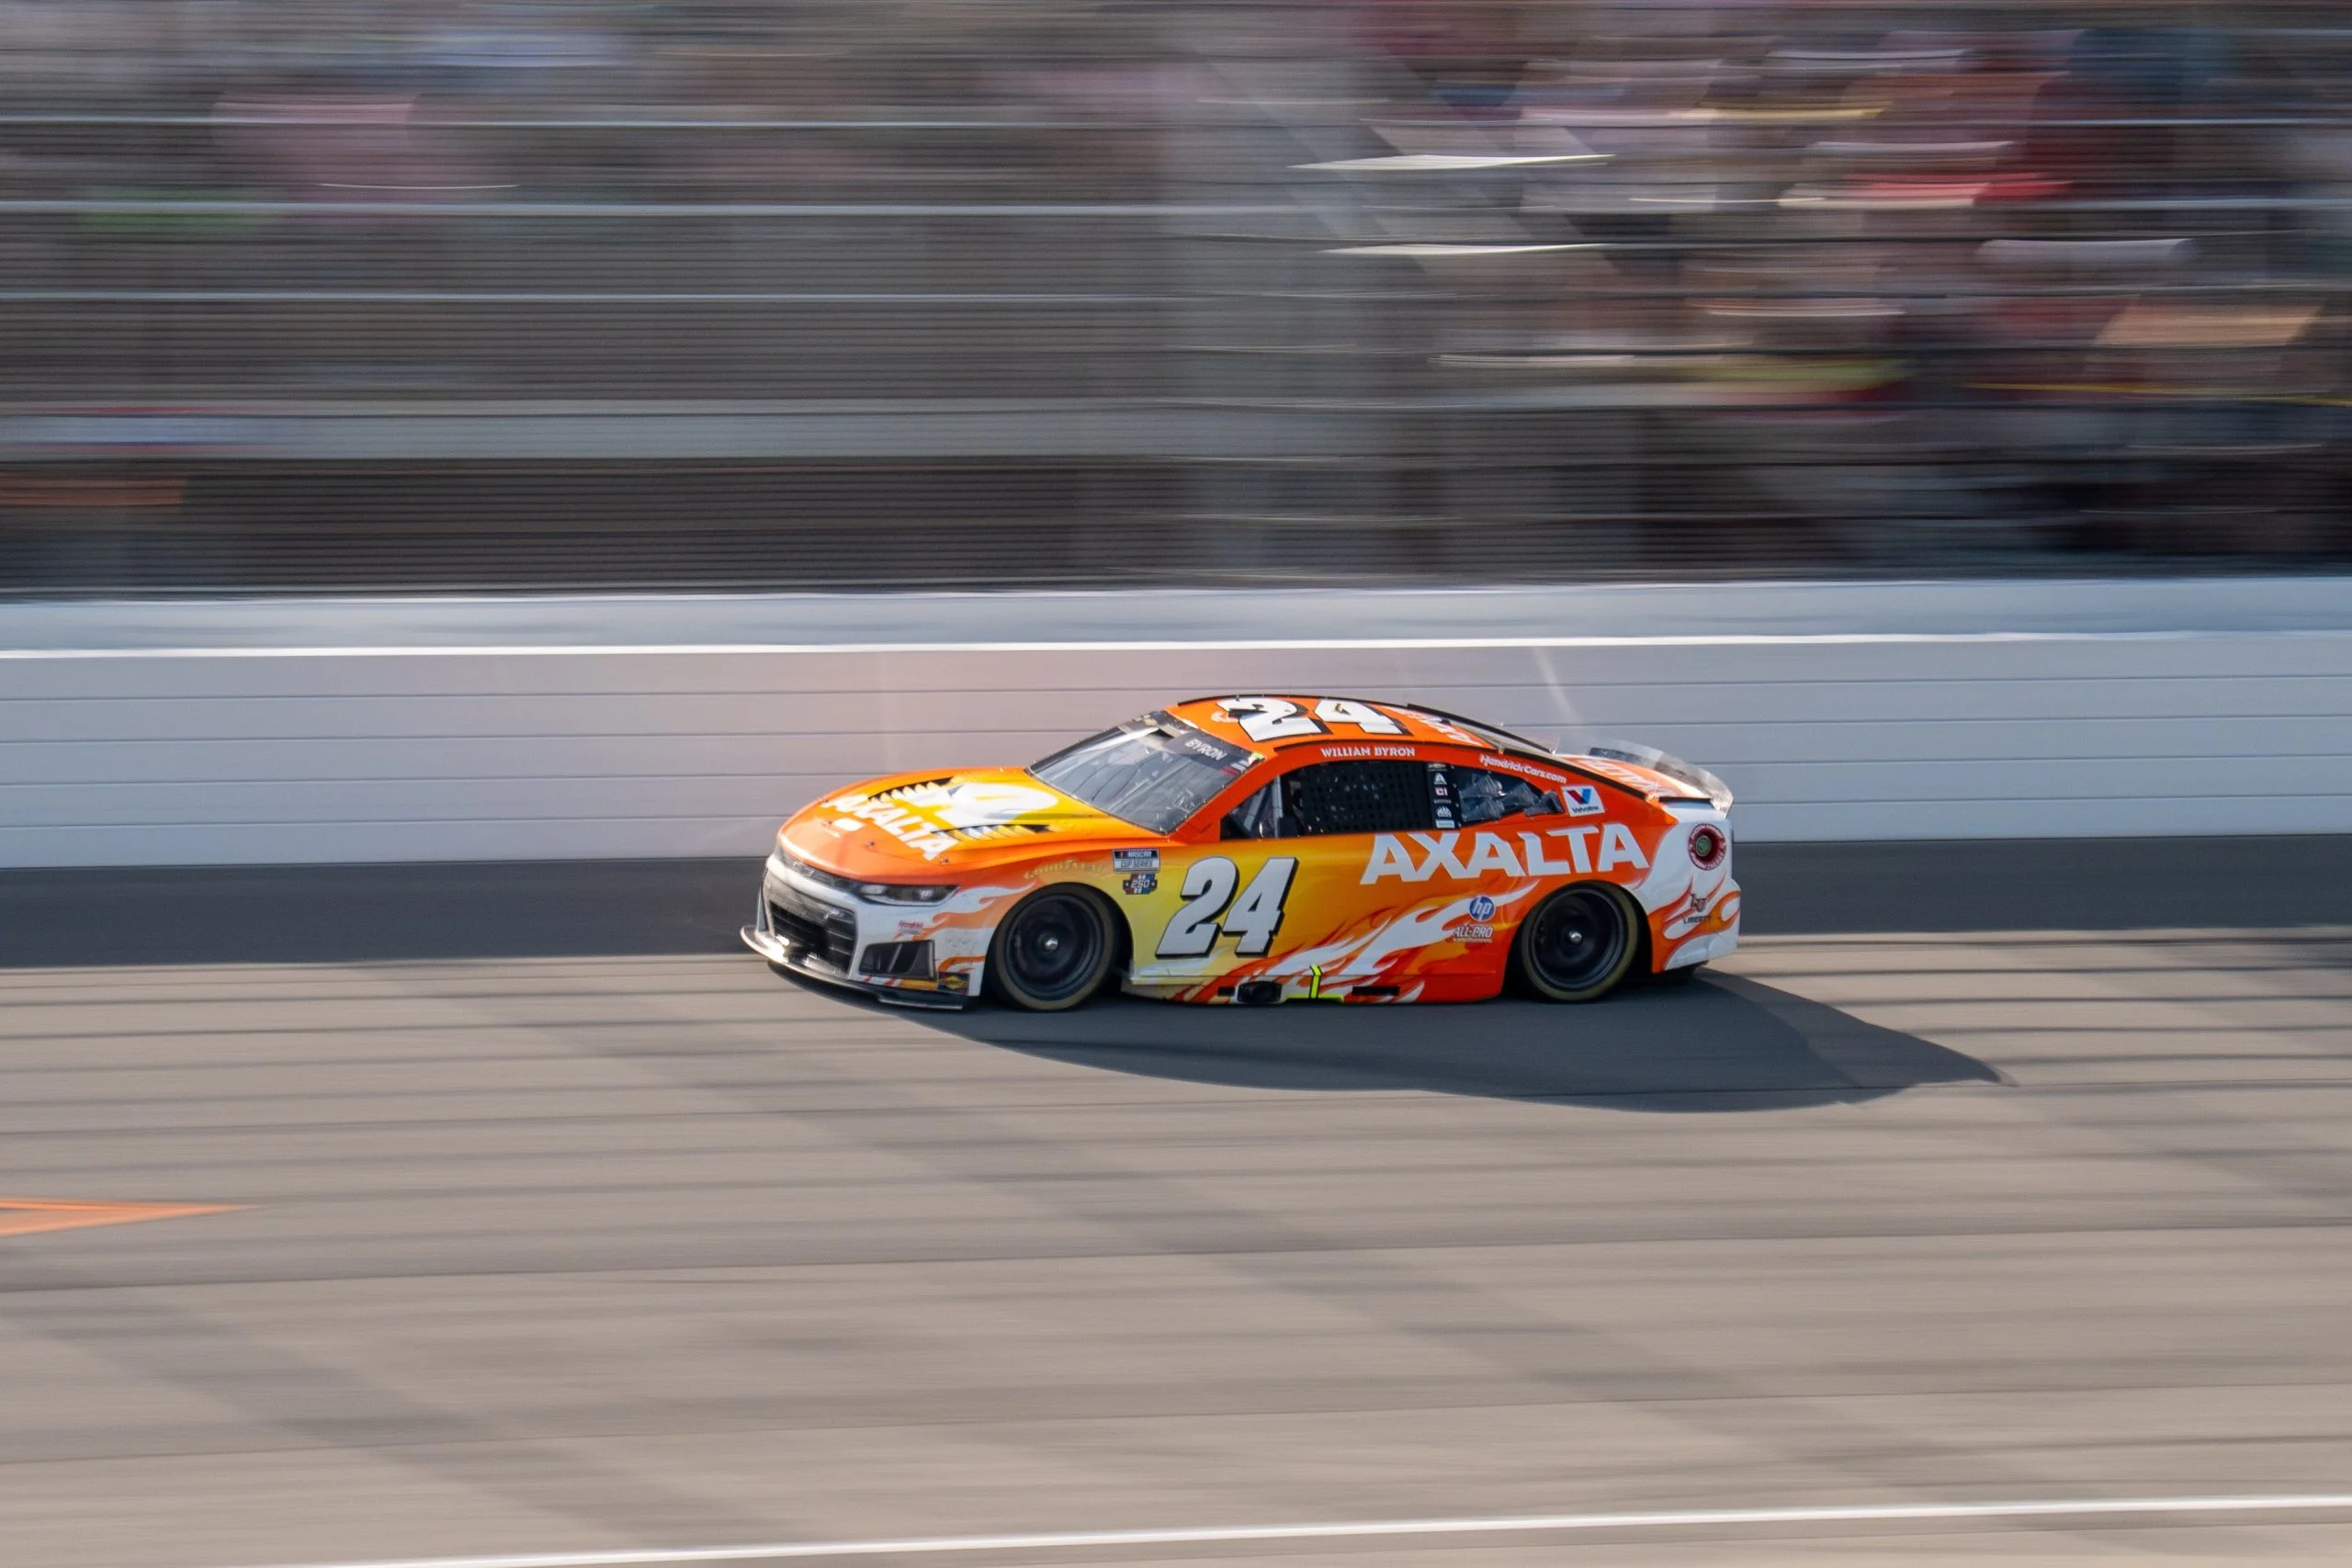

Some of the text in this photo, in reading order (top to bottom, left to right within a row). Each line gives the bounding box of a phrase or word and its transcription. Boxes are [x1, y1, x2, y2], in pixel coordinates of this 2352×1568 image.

[1216, 697, 1414, 742] 24
[1184, 739, 1228, 761] BYRON
[1320, 746, 1416, 759] WILLIAM BYRON
[1479, 753, 1567, 784] HendrickCars.com
[820, 793, 960, 862] AXALTA
[1127, 851, 1153, 859] NASCAR
[1360, 822, 1650, 886] AXALTA
[1130, 879, 1151, 889] 250
[1155, 855, 1300, 960] 24
[1472, 897, 1493, 920] hp
